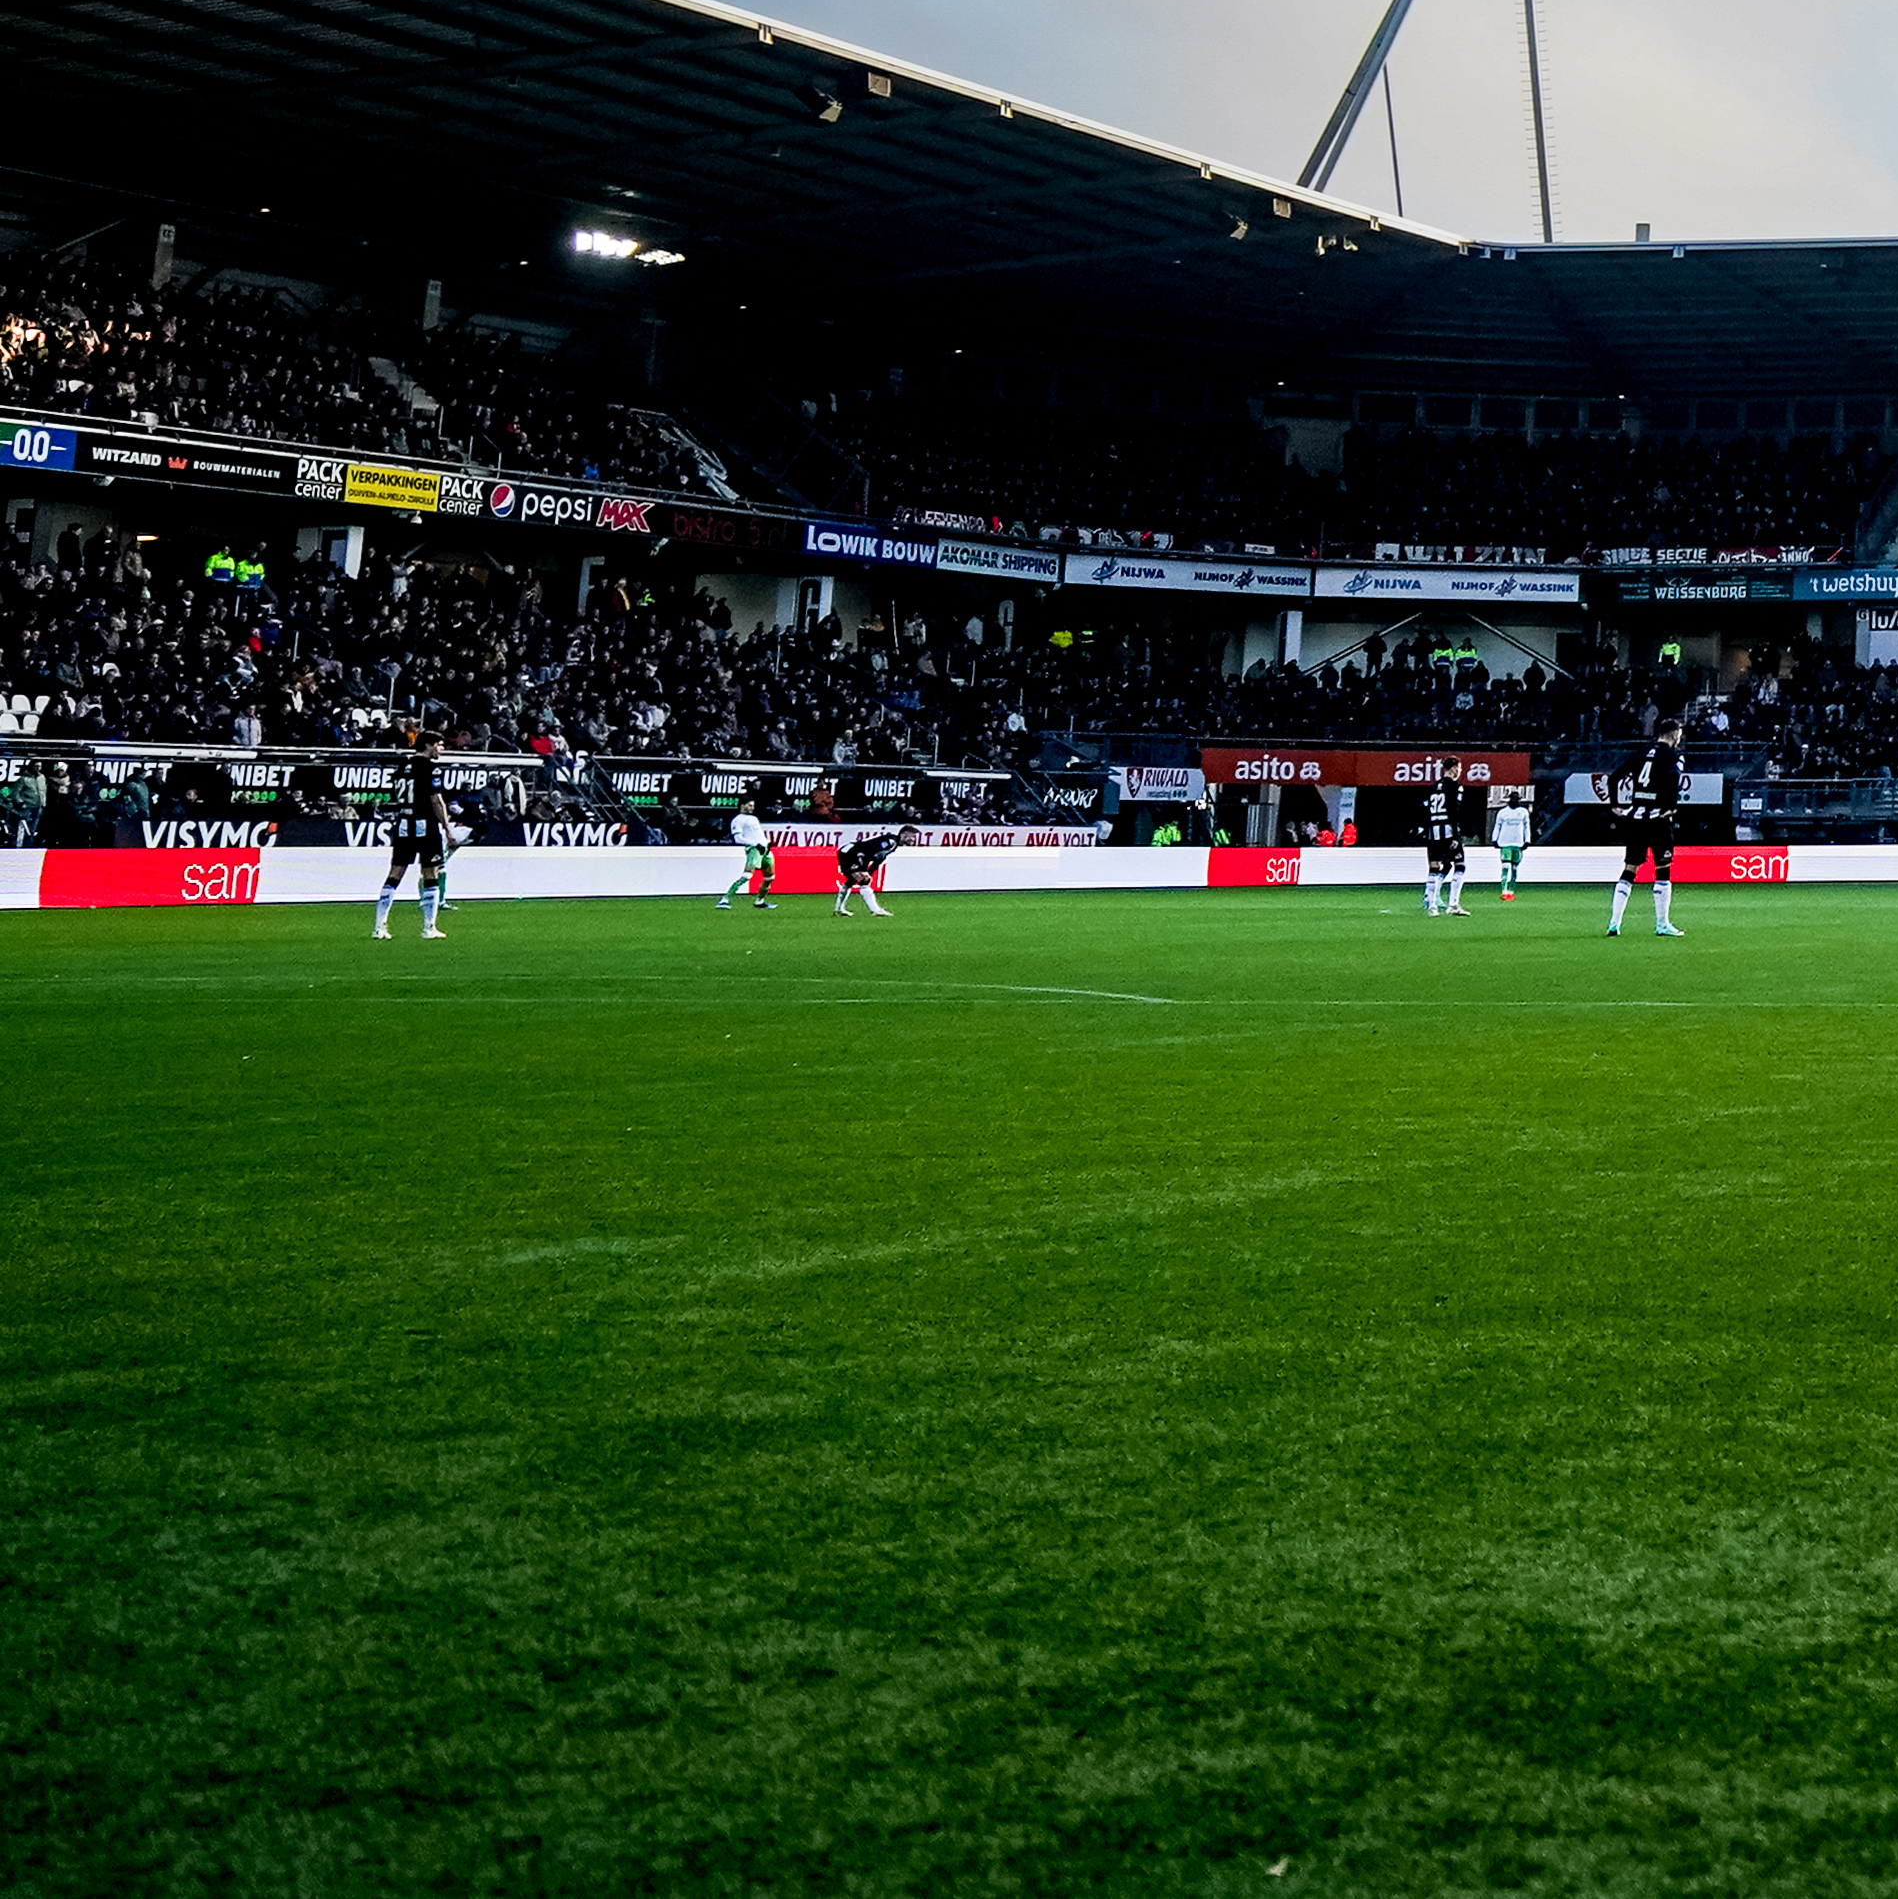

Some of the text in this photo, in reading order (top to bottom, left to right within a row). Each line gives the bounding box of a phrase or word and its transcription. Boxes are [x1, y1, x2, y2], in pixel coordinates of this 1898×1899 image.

[92, 447, 281, 479] WITZAND BOUWMATERIALEN
[297, 458, 344, 483] PACK
[295, 482, 342, 500] center
[351, 470, 437, 492] VERPAKKINGEN
[441, 477, 483, 500] PACK
[439, 499, 482, 516] center
[522, 491, 655, 533] pepsi MAX
[673, 510, 735, 542] bistro
[807, 525, 936, 564] LOWIK BOUW
[940, 545, 1057, 575] AKOMAR SHIPPING
[1121, 566, 1308, 586] NIJWA NIJHOF WASSINK
[1373, 578, 1575, 593] NIJWA NIJHOF WASSINK
[217, 764, 296, 788] NIBET
[333, 766, 398, 789] UNIBE
[1143, 770, 1190, 788] RIWALD
[1235, 754, 1295, 781] asito
[1393, 756, 1445, 783] asit
[1637, 761, 1653, 788] 4
[612, 773, 672, 793] UNIBET
[865, 779, 915, 798] UNIBET
[1430, 792, 1448, 815] 32
[142, 821, 279, 848] VISYMO
[344, 821, 394, 848] VIS
[523, 822, 628, 848] VISYMO
[980, 832, 1015, 847] VOLT
[1063, 832, 1096, 847] VOLT
